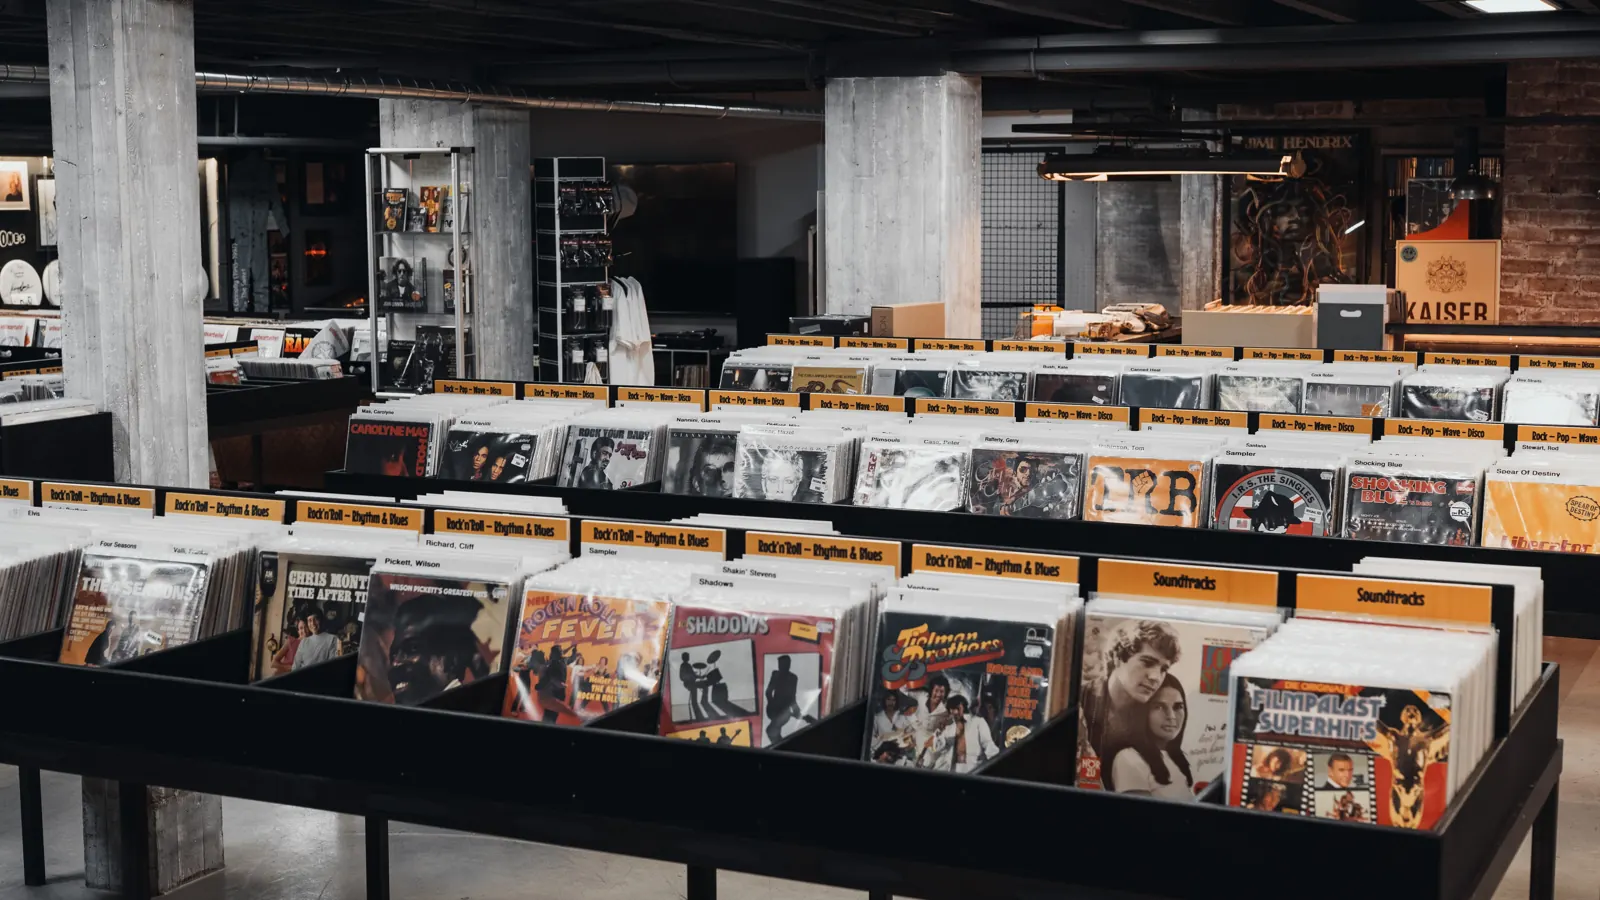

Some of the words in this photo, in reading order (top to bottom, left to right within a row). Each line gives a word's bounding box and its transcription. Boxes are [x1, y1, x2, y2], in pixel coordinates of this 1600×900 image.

[1283, 136, 1352, 149] HENDRIX
[1406, 302, 1487, 320] KAISER
[720, 395, 730, 404] Rock
[737, 396, 746, 404] Pop
[821, 400, 832, 409] Rock
[839, 401, 849, 410] Pop
[856, 402, 870, 410] Wave
[876, 403, 889, 411] Disco
[928, 404, 939, 412] Rock
[947, 405, 956, 413] Pop
[964, 406, 978, 414] Wave
[986, 406, 999, 414] Disco
[1038, 408, 1051, 417] Rock
[1058, 410, 1068, 419] Pop
[1076, 411, 1091, 419] Wave
[1098, 412, 1112, 420] Disco
[1152, 413, 1164, 423] Rock
[1173, 415, 1184, 424] Pop
[1192, 416, 1208, 424] Wave
[1214, 417, 1230, 426] Disco
[1272, 420, 1286, 428] Rock
[1295, 421, 1306, 431] Pop
[1314, 422, 1331, 430] Wave
[1338, 423, 1354, 432] Disco
[350, 424, 404, 436] CAROLYNE
[405, 426, 428, 437] MAS
[579, 428, 601, 436] ROCK
[604, 429, 625, 438] YOUR
[627, 430, 650, 440] BABY
[1398, 425, 1412, 434] Rock
[1422, 426, 1433, 436] Pop
[1443, 427, 1460, 436] Wave
[1468, 428, 1484, 438] Disco
[984, 436, 1004, 445] Rafferty,
[1532, 431, 1547, 441] Rock
[1557, 433, 1569, 443] Pop
[1579, 434, 1597, 444] Wave
[3, 486, 19, 497] Blues
[1231, 476, 1258, 499] I.R.S.
[1257, 475, 1276, 484] THE
[1279, 476, 1316, 504] SINGLES
[1351, 477, 1446, 494] SHOCKING
[51, 489, 82, 502] Rock'n'Roll
[91, 492, 116, 505] Rhythm
[117, 494, 122, 504] &
[124, 494, 140, 506] Blues
[1361, 490, 1407, 504] BLUE
[175, 499, 208, 512] Rock'n'Roll
[217, 502, 242, 516] Rhythm
[244, 504, 249, 516] &
[251, 505, 269, 517] Blues
[1570, 499, 1589, 511] SPEAR
[1590, 504, 1598, 512] OF
[1570, 506, 1595, 518] DESTINY
[308, 507, 342, 521] Rock'n'Roll
[352, 510, 380, 525] Rhythm
[382, 513, 388, 524] &
[390, 513, 408, 526] Blues
[447, 518, 484, 532] Rock'n'Roll
[494, 521, 524, 536] Rhythm
[526, 524, 532, 536] &
[534, 525, 554, 537] Blues
[594, 527, 634, 542] Rock'n'Roll
[645, 531, 676, 546] Rhythm
[679, 534, 685, 545] &
[688, 535, 708, 547] Blues
[426, 539, 457, 550] Richard,
[459, 542, 474, 550] Cliff
[758, 540, 801, 555] Rock'n'Roll
[813, 543, 847, 560] Rhythm
[850, 547, 856, 559] &
[859, 548, 882, 561] Blues
[589, 548, 617, 556] Sampler
[385, 558, 412, 567] Pickett,
[415, 560, 440, 568] Wilson
[926, 553, 972, 569] Rock'n'Roll
[985, 557, 1022, 574] Rhythm
[1025, 561, 1031, 575] &
[1035, 562, 1060, 576] Blues
[722, 566, 748, 576] Shakin'
[750, 569, 776, 578] Stevens
[82, 577, 108, 592] THE
[288, 570, 327, 587] CHRIS
[330, 573, 370, 590] MONT
[699, 578, 734, 588] Shadows
[1154, 571, 1216, 591] Soundtracks
[288, 586, 314, 600] TIME
[317, 588, 352, 602] AFTER
[354, 590, 368, 603] TI
[390, 583, 412, 592] WILSON
[414, 585, 442, 595] PICKETT'S
[443, 587, 473, 597] GREATEST
[1357, 587, 1425, 606] Soundtracks
[542, 618, 638, 640] FEVER
[686, 616, 768, 634] SHADOWS
[898, 622, 978, 648] Tielman
[901, 638, 1003, 662] Brothers
[986, 663, 1017, 675] ROCK
[1020, 667, 1043, 676] AND
[1008, 687, 1030, 698] OUR
[1005, 697, 1038, 710] FIRST
[1251, 688, 1385, 718] FILMPALAST
[1005, 708, 1033, 720] LOVE
[1259, 712, 1377, 741] SUPERHITS
